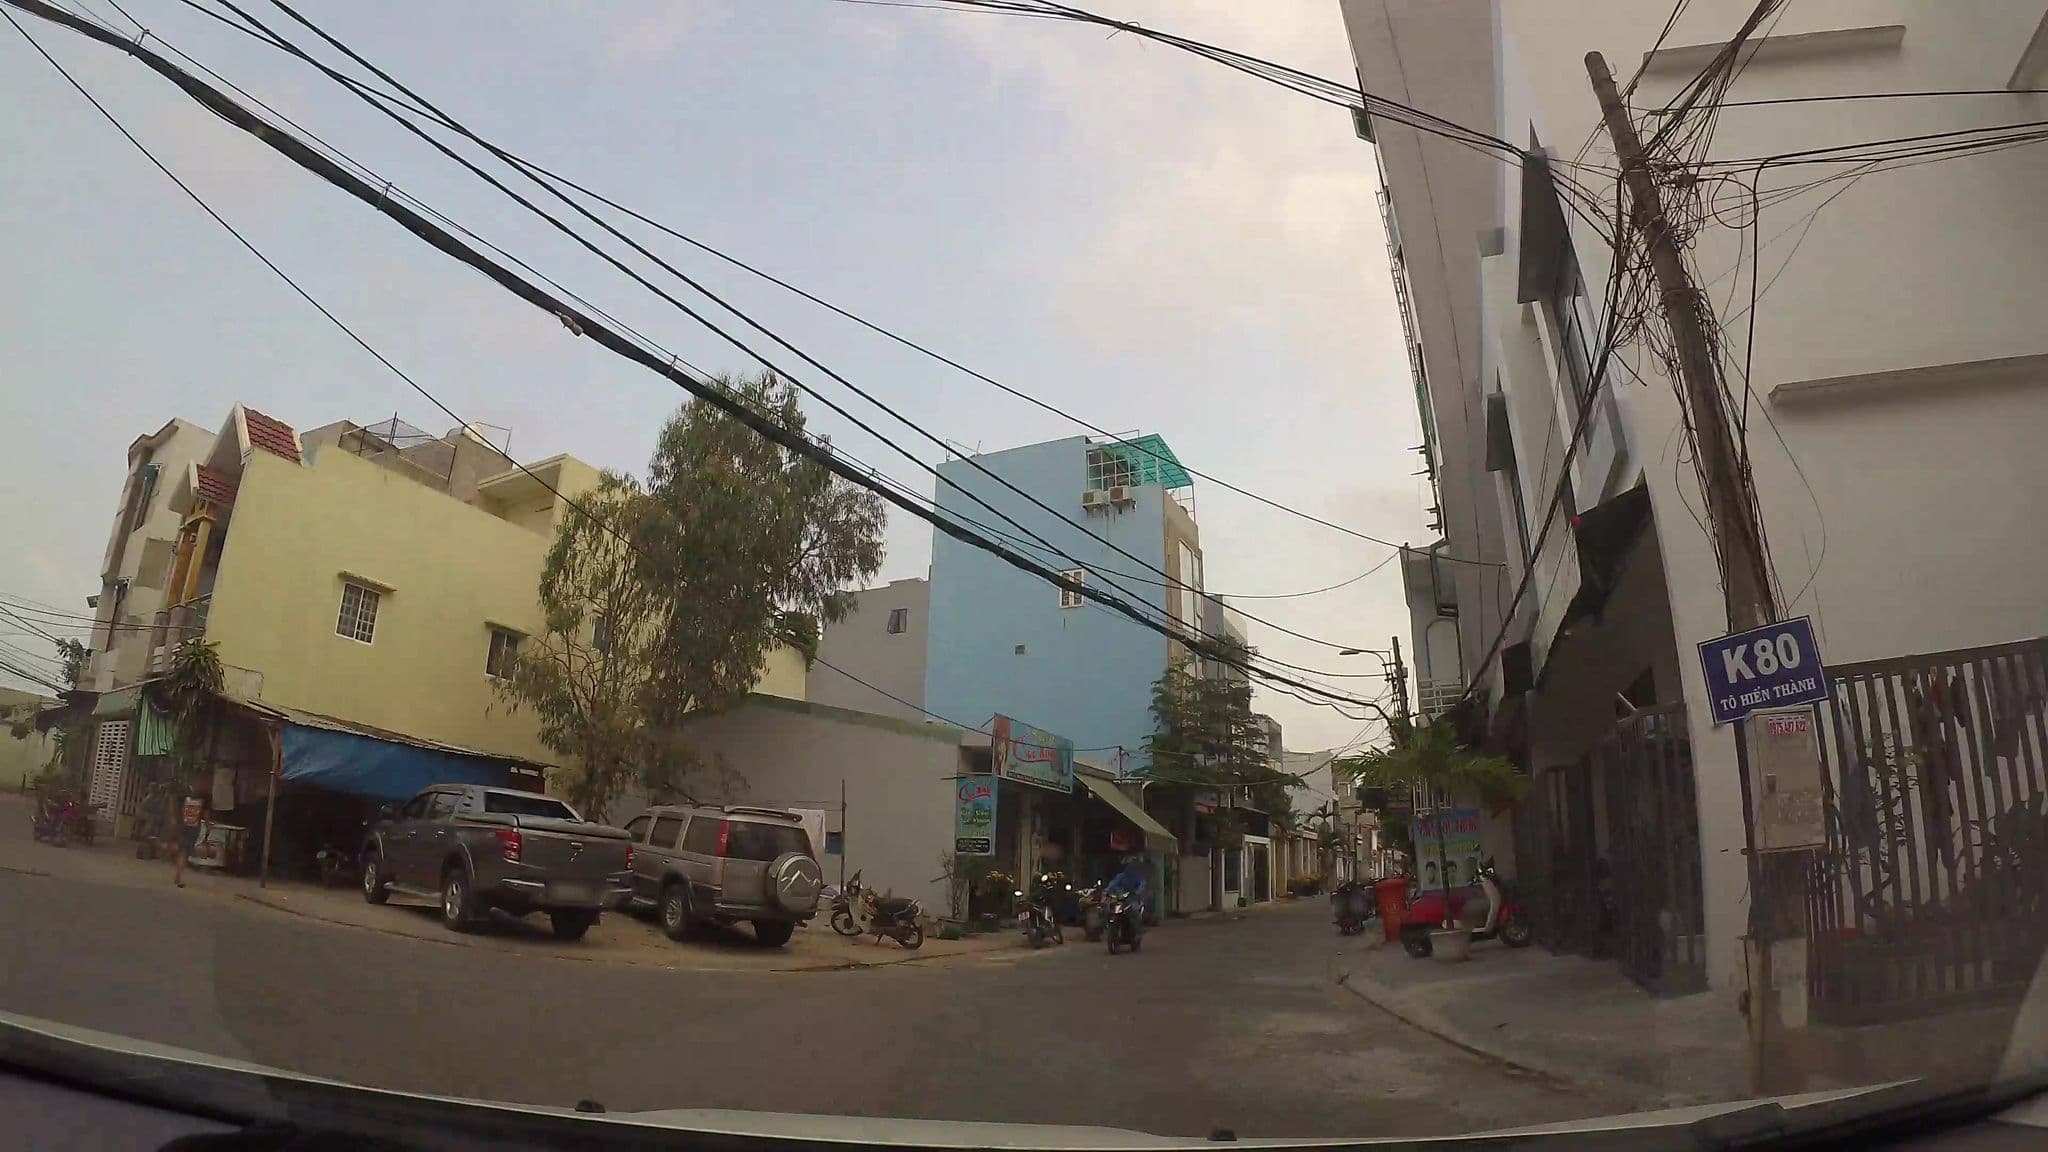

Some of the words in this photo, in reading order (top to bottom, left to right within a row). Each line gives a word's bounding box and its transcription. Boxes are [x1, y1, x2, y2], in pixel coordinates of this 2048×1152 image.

[1721, 633, 1801, 684] K80
[1720, 695, 1737, 711] TÔ
[1773, 677, 1816, 698] THÀNH
